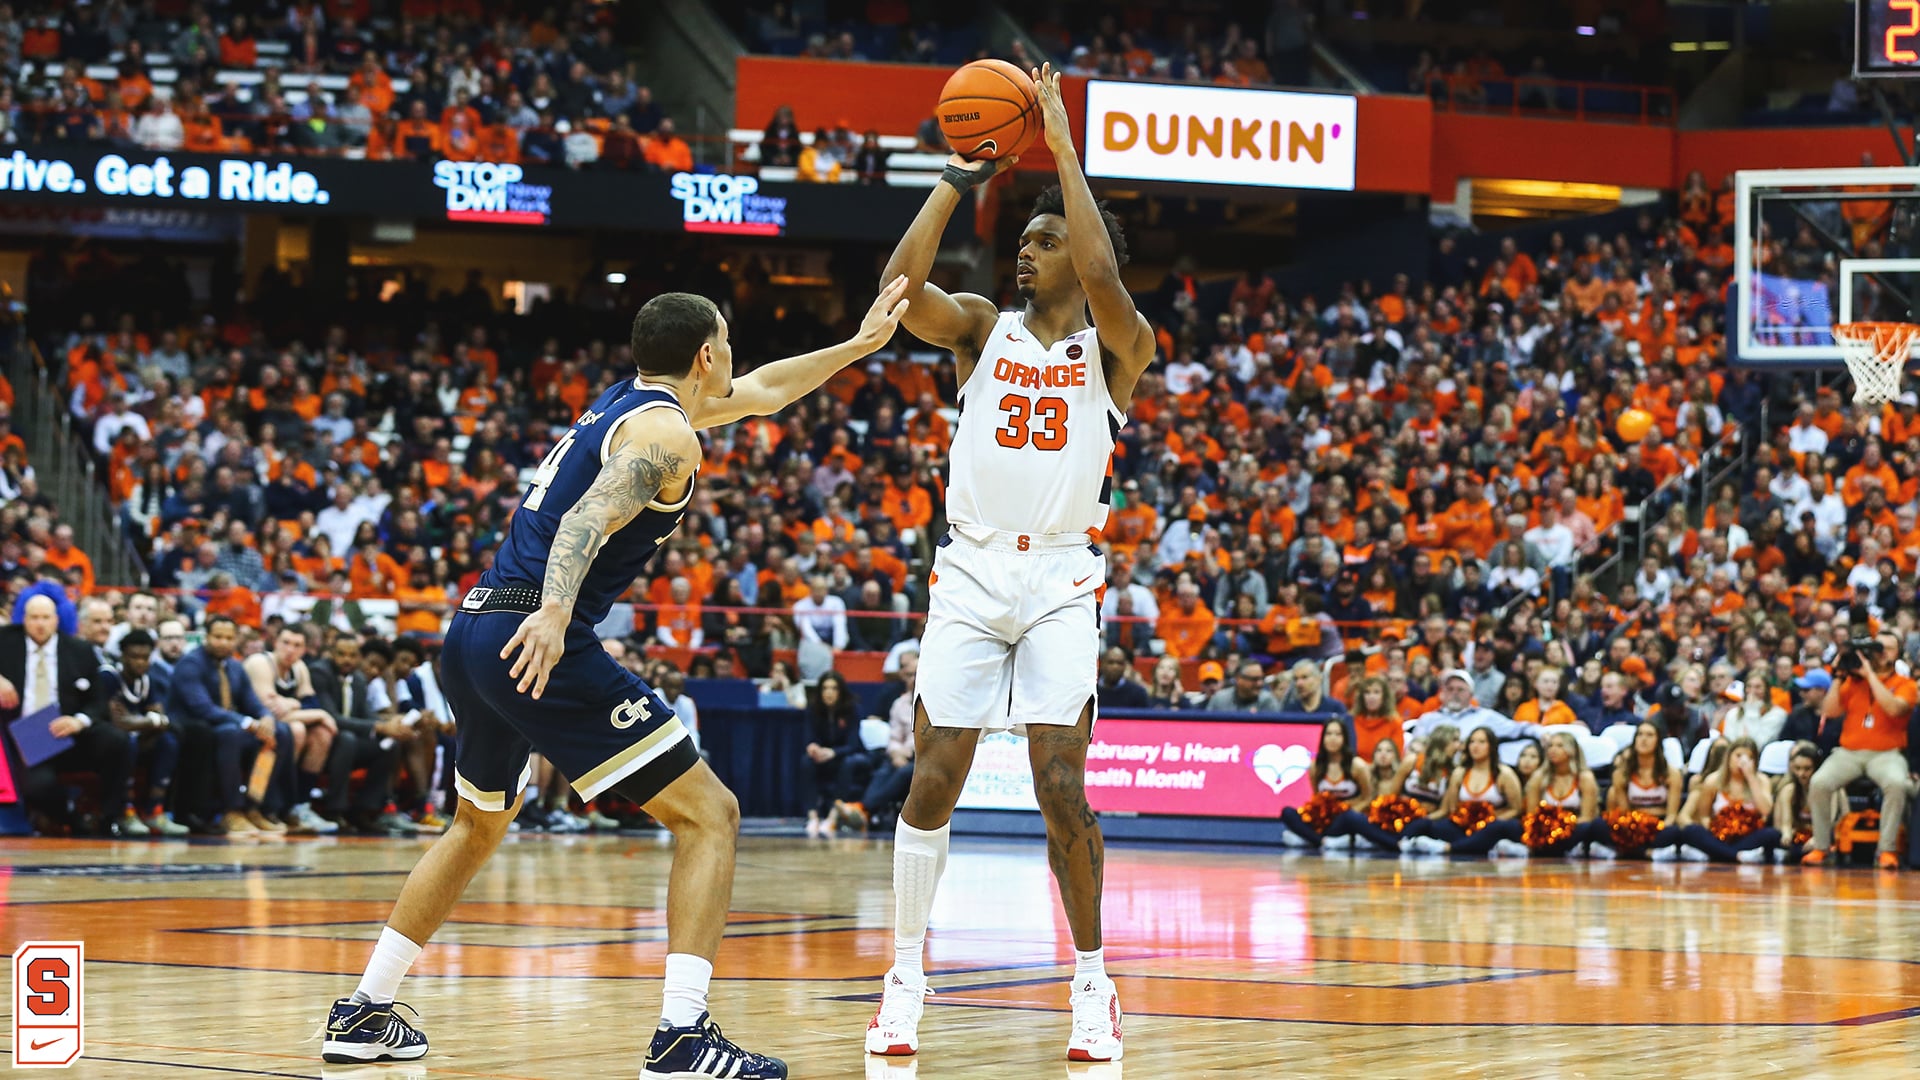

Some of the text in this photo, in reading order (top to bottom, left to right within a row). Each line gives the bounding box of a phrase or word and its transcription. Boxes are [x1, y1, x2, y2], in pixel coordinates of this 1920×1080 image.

[1885, 0, 1919, 62] 2
[944, 112, 980, 123] SYRACUSE
[1103, 111, 1341, 164] DUNKIN'
[0, 150, 330, 204] rive. Get a Ride.
[433, 160, 523, 189] STOP
[670, 172, 758, 201] STOP
[447, 185, 507, 213] DWI
[684, 197, 742, 224] DWI
[993, 357, 1086, 390] ORANGE
[995, 393, 1068, 451] 33
[522, 428, 578, 512] 4
[1016, 534, 1031, 552] S
[610, 696, 652, 730] GT
[1086, 741, 1240, 764] ebruary is Heart
[1084, 768, 1206, 789] ealth Month!
